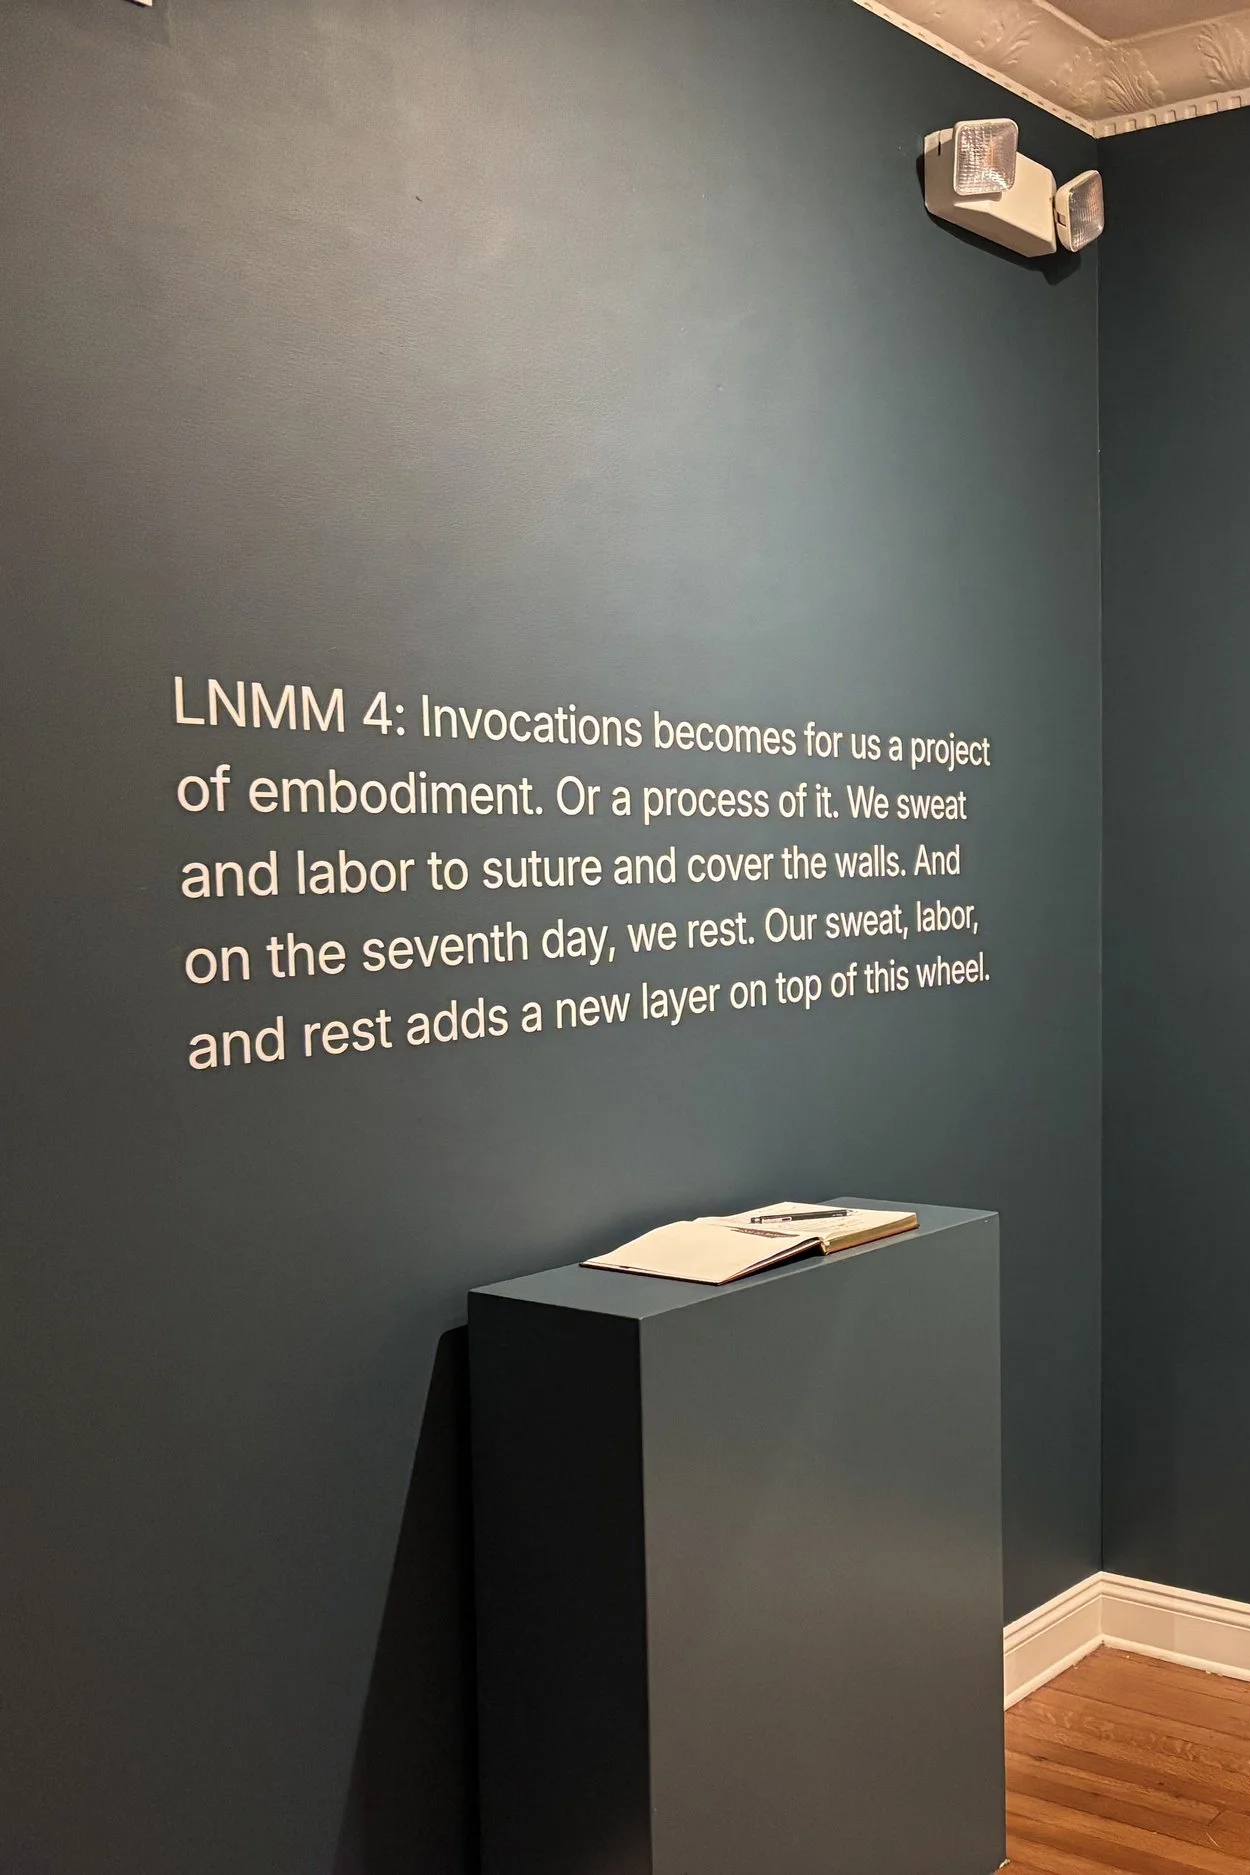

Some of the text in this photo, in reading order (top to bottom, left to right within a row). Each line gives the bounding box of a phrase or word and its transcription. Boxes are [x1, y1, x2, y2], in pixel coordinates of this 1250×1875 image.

[174, 675, 991, 772] LNMM 4: Invocations becomes for us a project
[177, 763, 968, 826] of embodiment. Or a process of it. We sweat
[181, 843, 961, 899] and labor to suture and cover the walls. And
[185, 899, 979, 984] on the seventh day, we rest. Our sweat, labor,
[188, 951, 990, 1070] and rest adds a new layer on top of this wheel.
